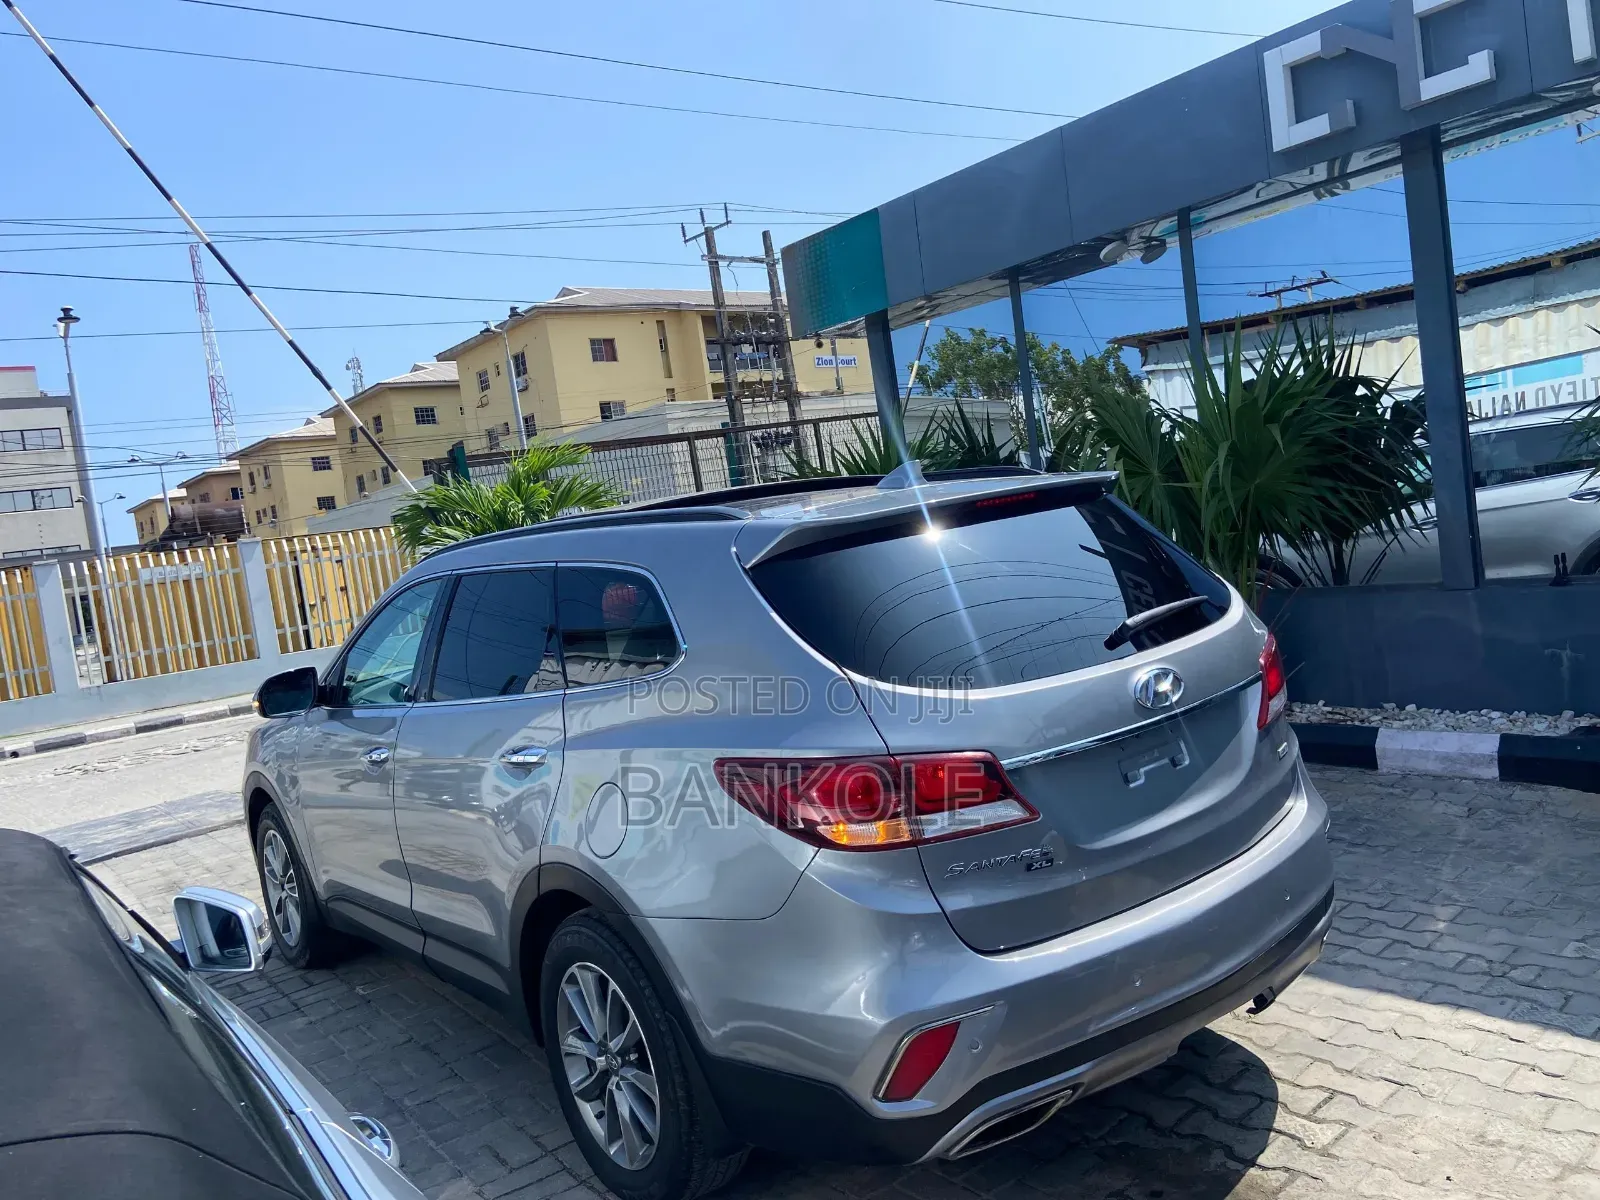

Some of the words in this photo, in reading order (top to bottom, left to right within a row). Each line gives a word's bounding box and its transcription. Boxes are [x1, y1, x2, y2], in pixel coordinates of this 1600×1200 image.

[815, 357, 834, 366] Zion
[837, 356, 857, 366] ourt
[1030, 860, 1052, 871] XL
